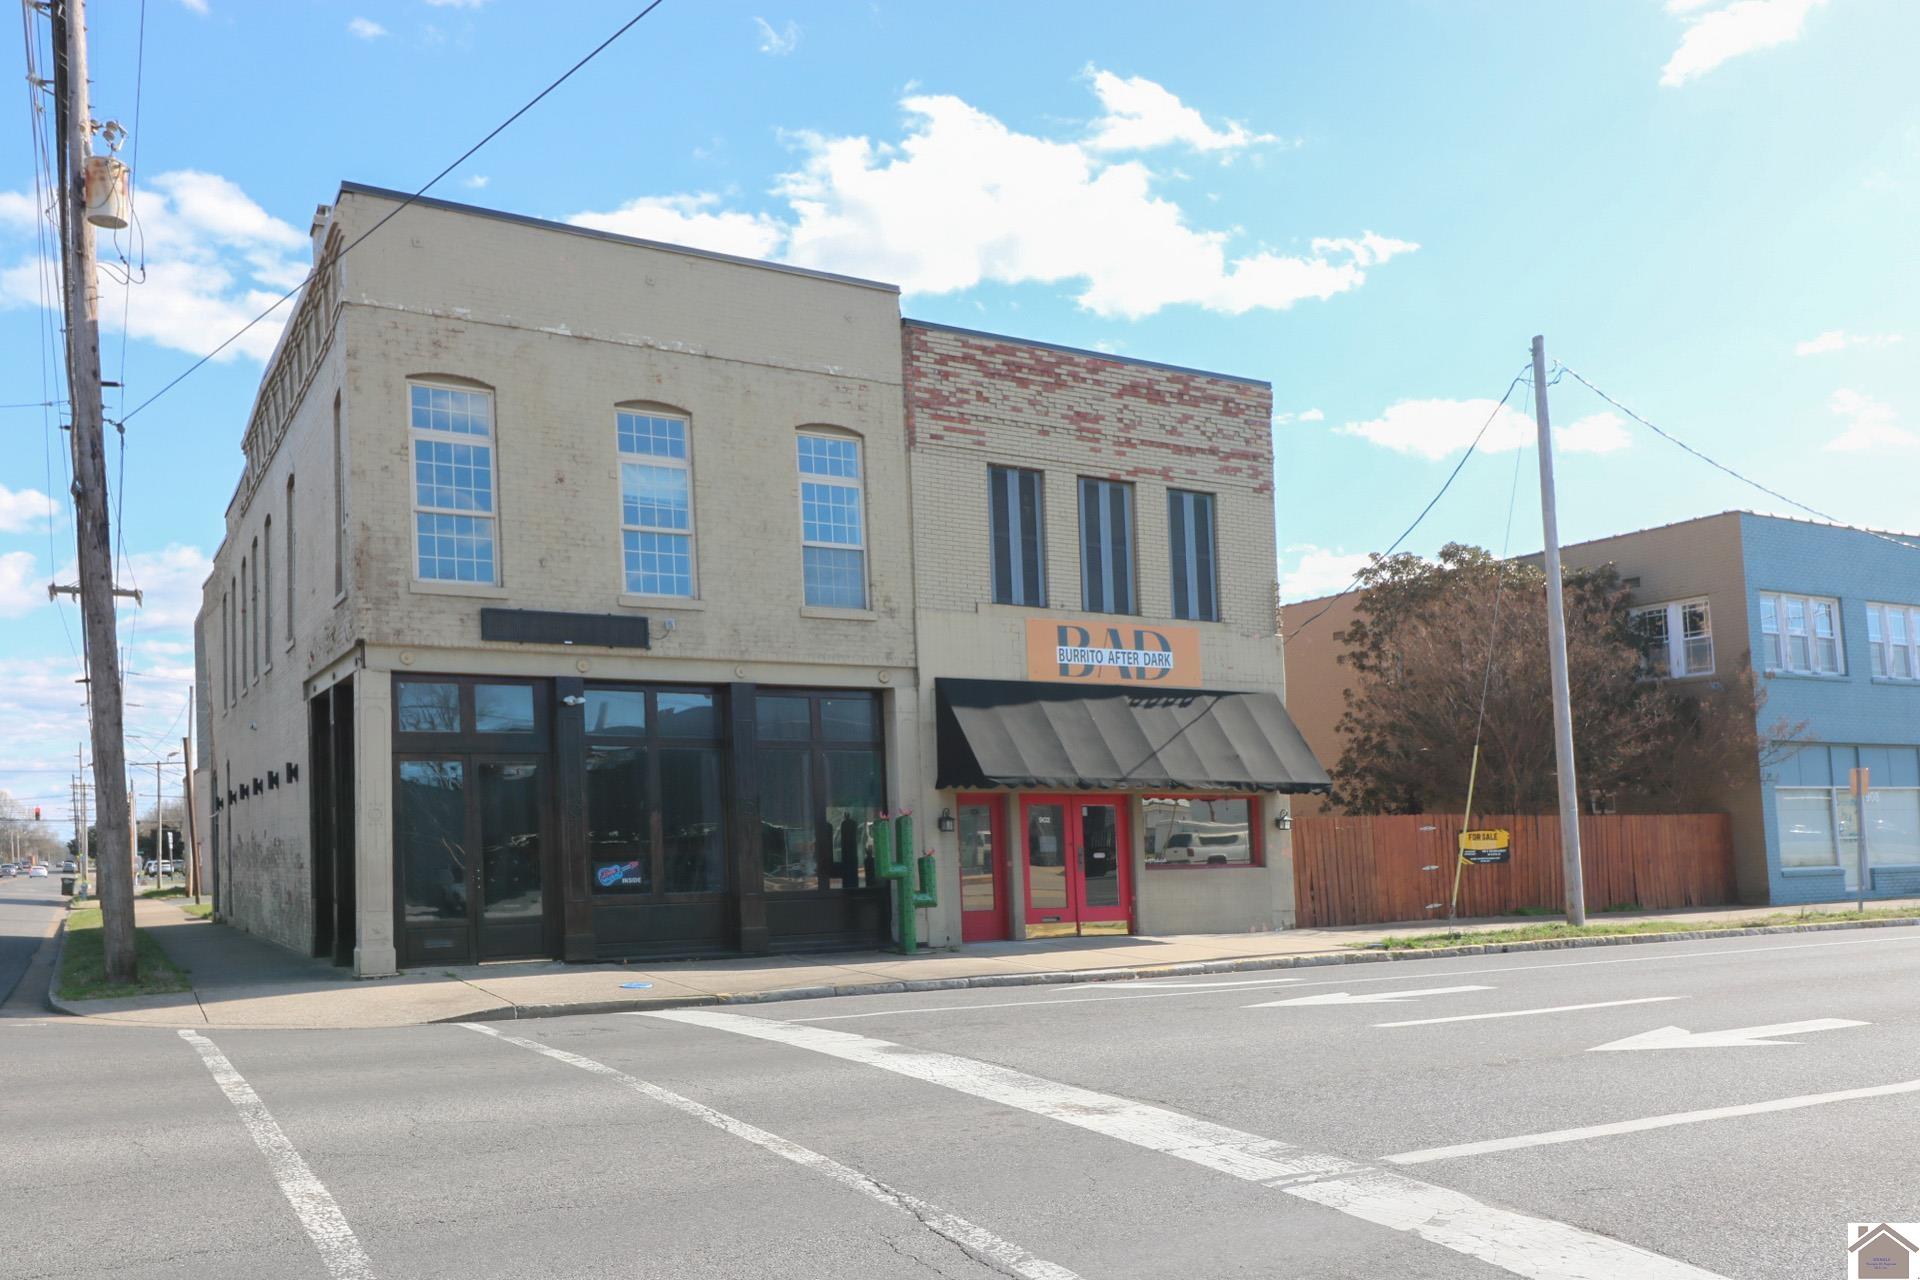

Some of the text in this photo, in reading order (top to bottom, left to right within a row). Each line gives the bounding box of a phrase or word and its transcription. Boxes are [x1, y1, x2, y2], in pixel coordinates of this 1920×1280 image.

[1057, 625, 1173, 680] BAD
[1059, 648, 1171, 667] BURRITO AFTER DARK
[1469, 833, 1498, 841] FOR SALE
